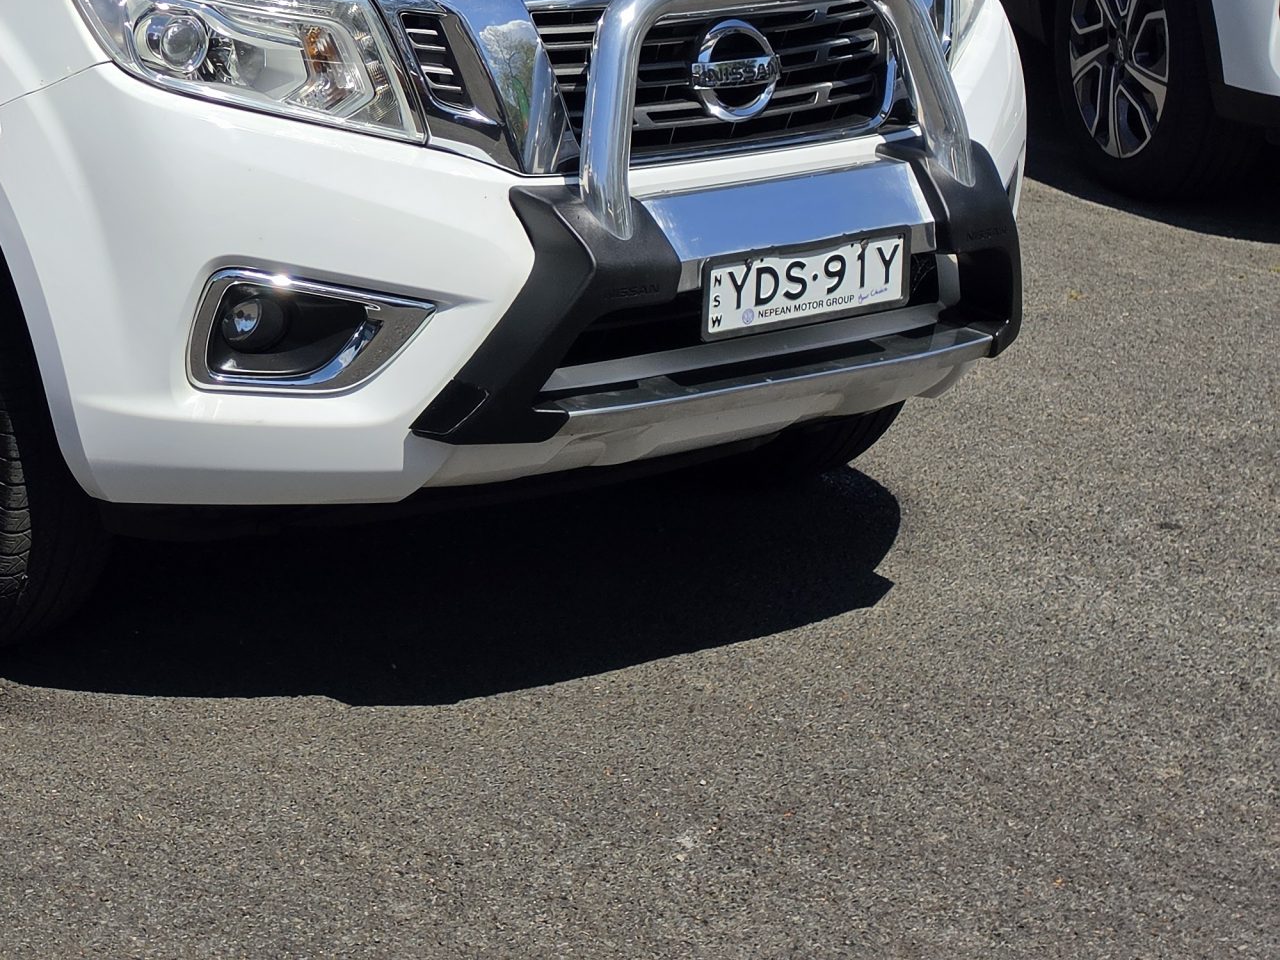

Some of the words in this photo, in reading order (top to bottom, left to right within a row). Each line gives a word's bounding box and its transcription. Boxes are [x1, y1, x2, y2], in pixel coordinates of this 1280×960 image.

[704, 61, 779, 85] NISSAN
[757, 304, 792, 319] NEPEAN
[793, 299, 825, 314] MOTOR
[825, 294, 855, 308] GROUP
